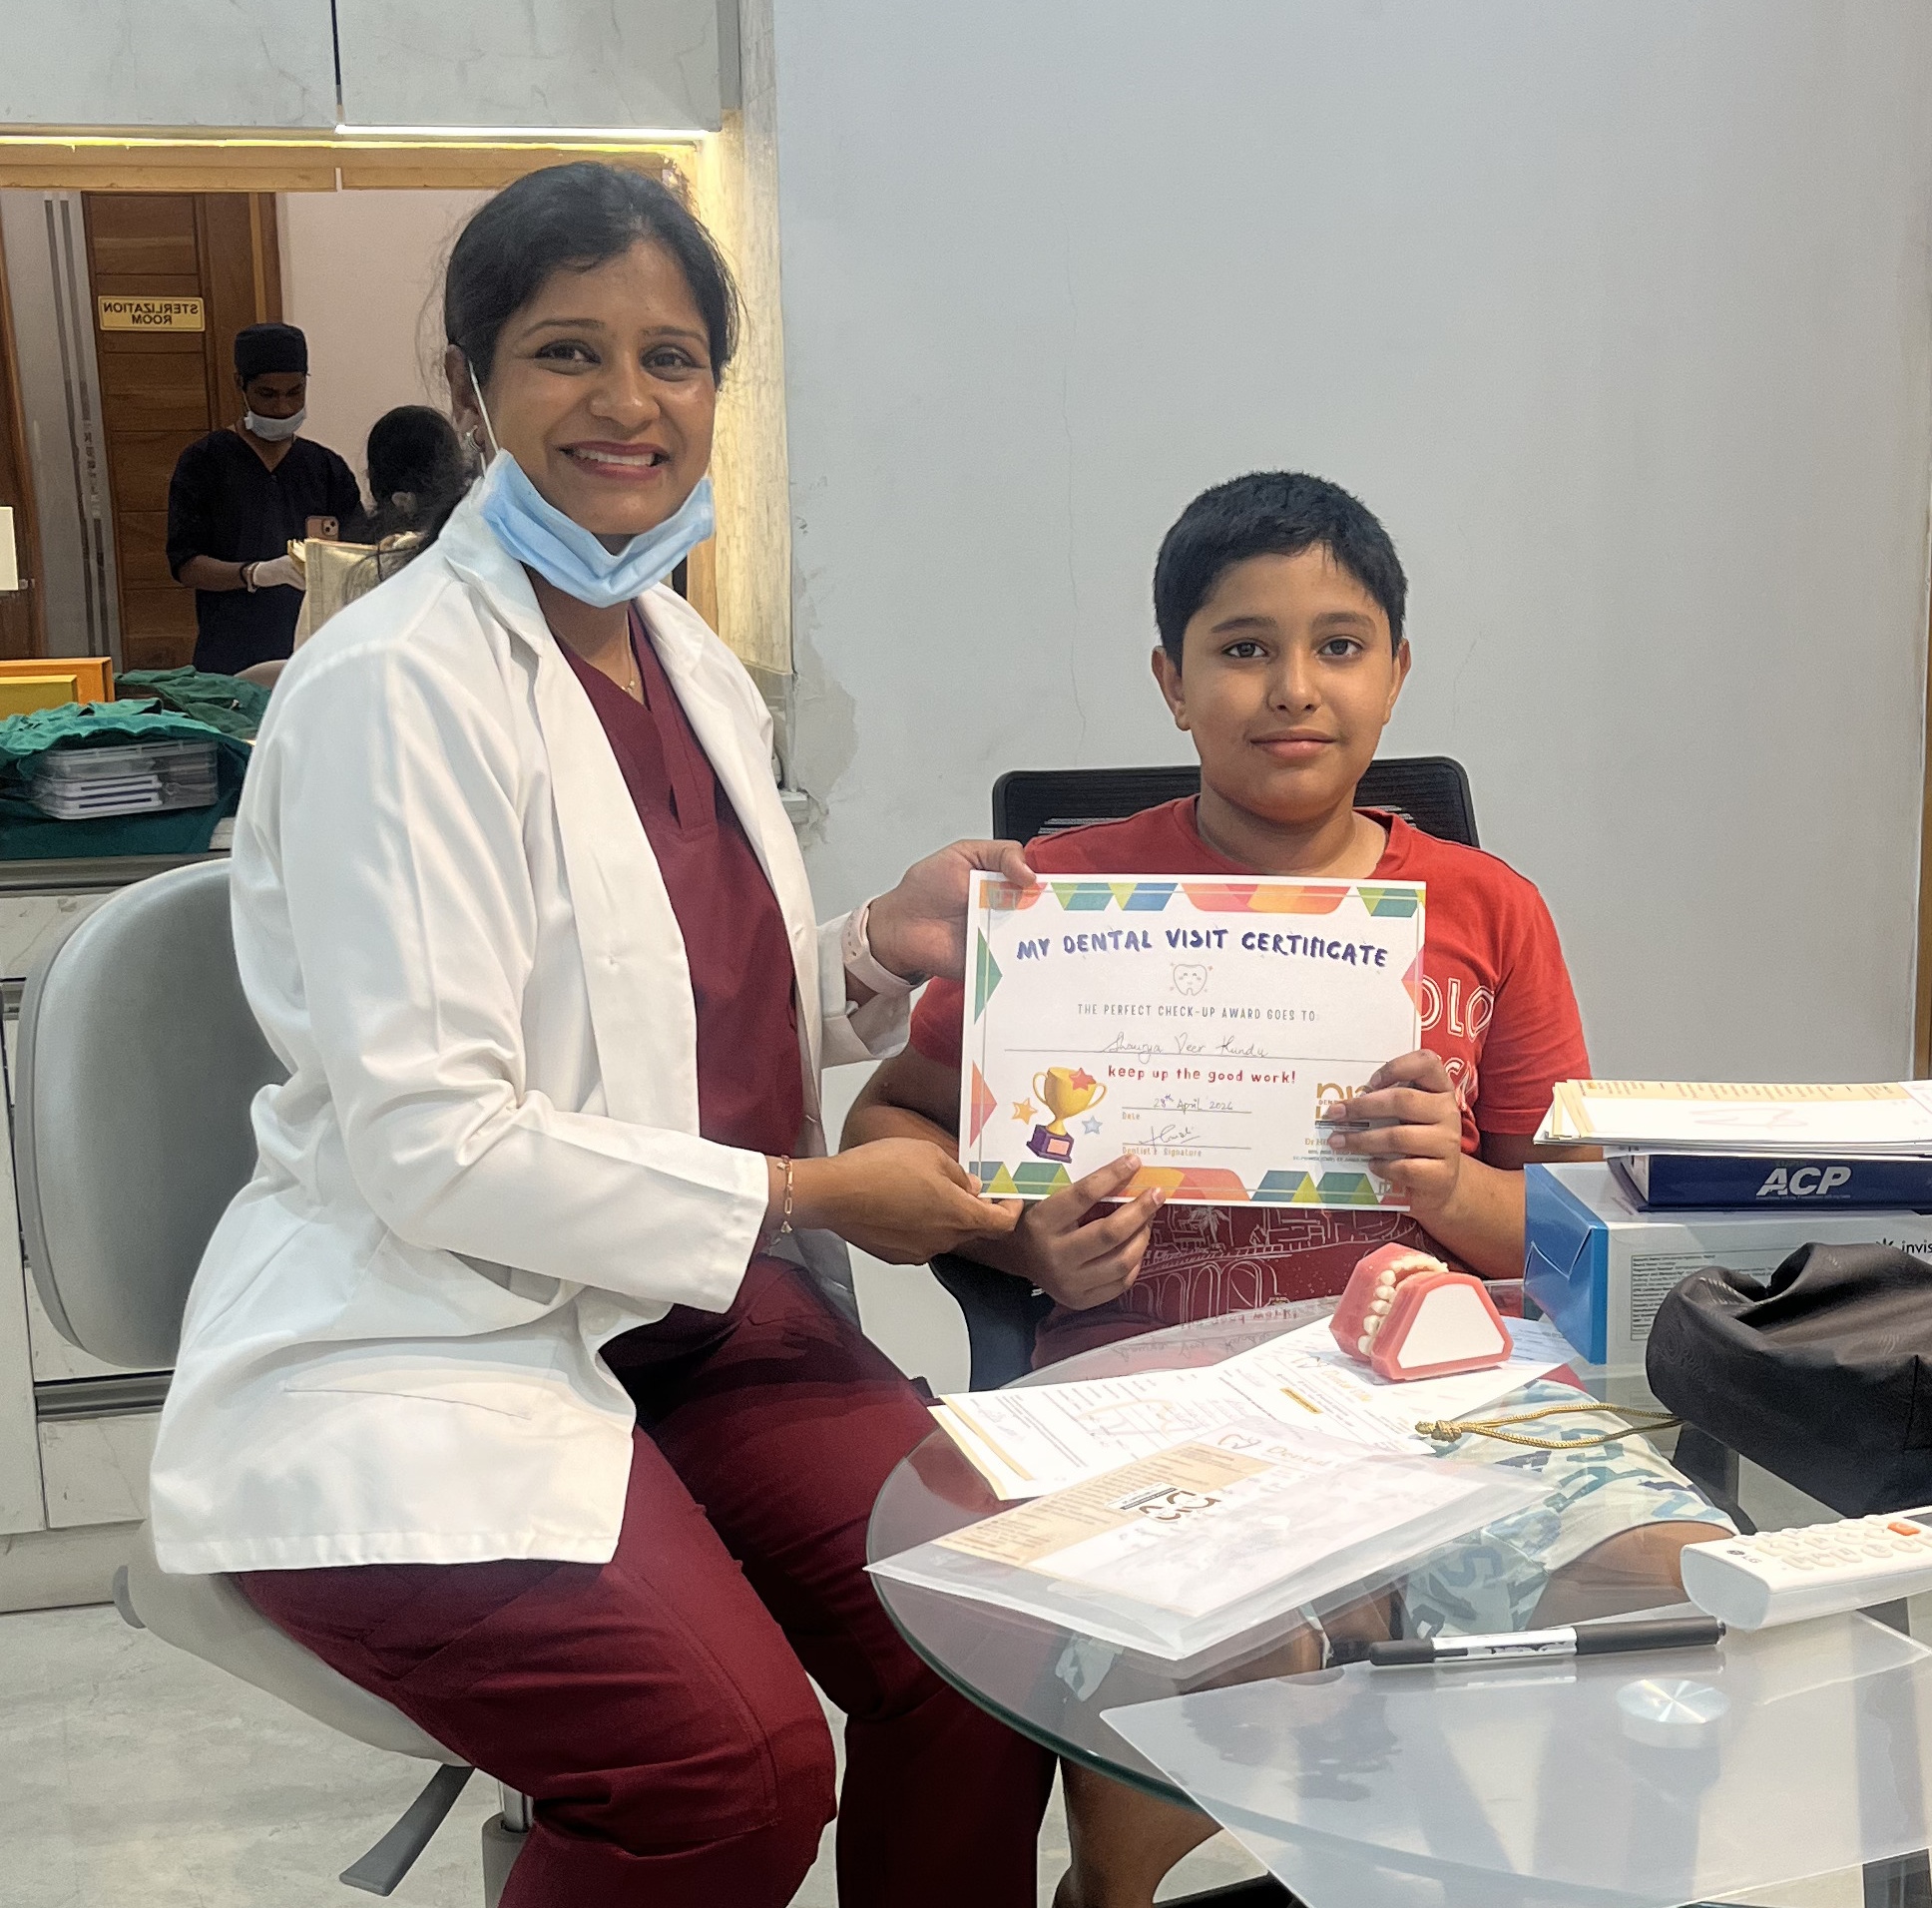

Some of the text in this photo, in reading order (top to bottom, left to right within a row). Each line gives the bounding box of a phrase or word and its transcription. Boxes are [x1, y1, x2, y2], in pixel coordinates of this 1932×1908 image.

[1017, 928, 1388, 967] MY DENTAL VISIT CERTIFICATE
[1078, 1003, 1315, 1021] THE PERFECT CHECK-UP AWARD GOES TO
[1108, 1065, 1296, 1085] keep up the good work!
[1177, 1098, 1202, 1115] April
[1122, 1112, 1141, 1121] Date
[1163, 1148, 1203, 1158] Signature
[1756, 1166, 1851, 1195] ACP
